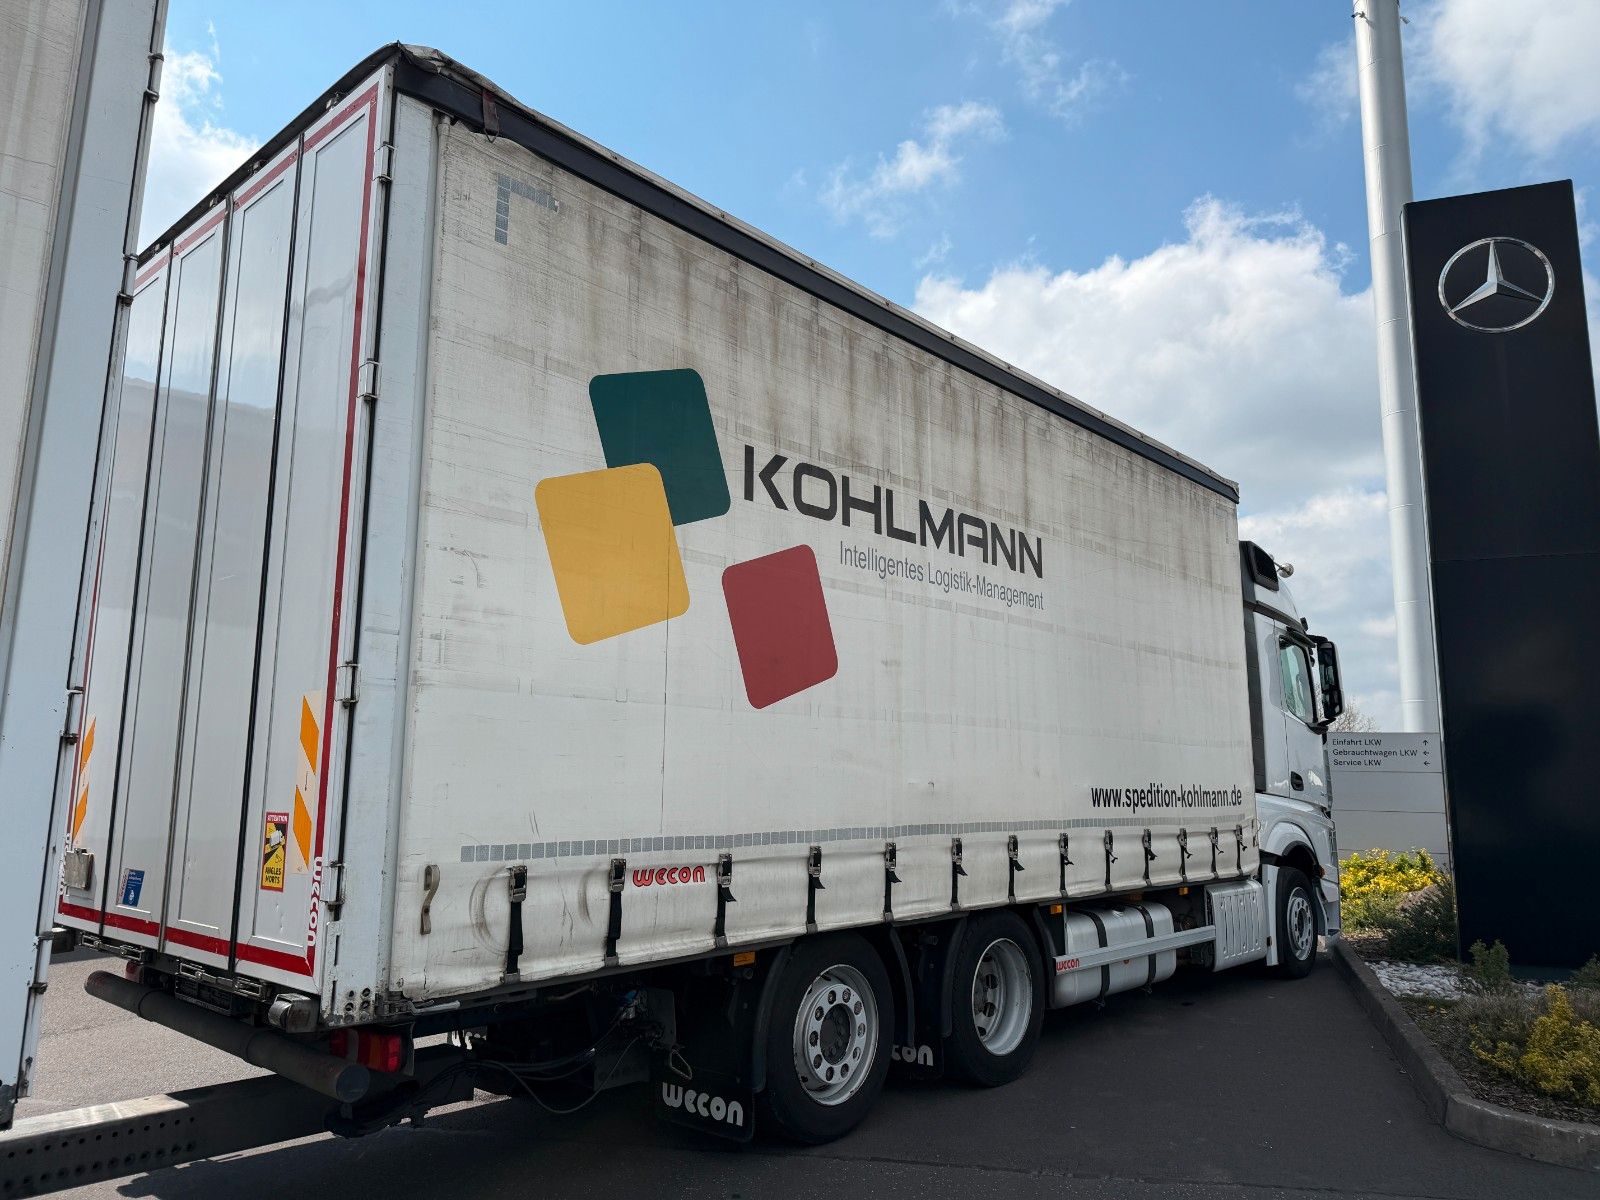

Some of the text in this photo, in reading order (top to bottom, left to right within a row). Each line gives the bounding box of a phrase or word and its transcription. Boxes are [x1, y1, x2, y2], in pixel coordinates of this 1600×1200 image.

[744, 444, 1044, 579] KOHLMANN
[839, 540, 1045, 611] Intelligentes Logistik-Management
[1332, 738, 1362, 746] Einfahrt
[1332, 748, 1418, 758] Gebrauchtwagen LKW
[1333, 758, 1362, 766] Service
[1091, 782, 1242, 814] www.spedition-kohlmann.de
[265, 866, 282, 876] ANGLES
[892, 1044, 934, 1067] con
